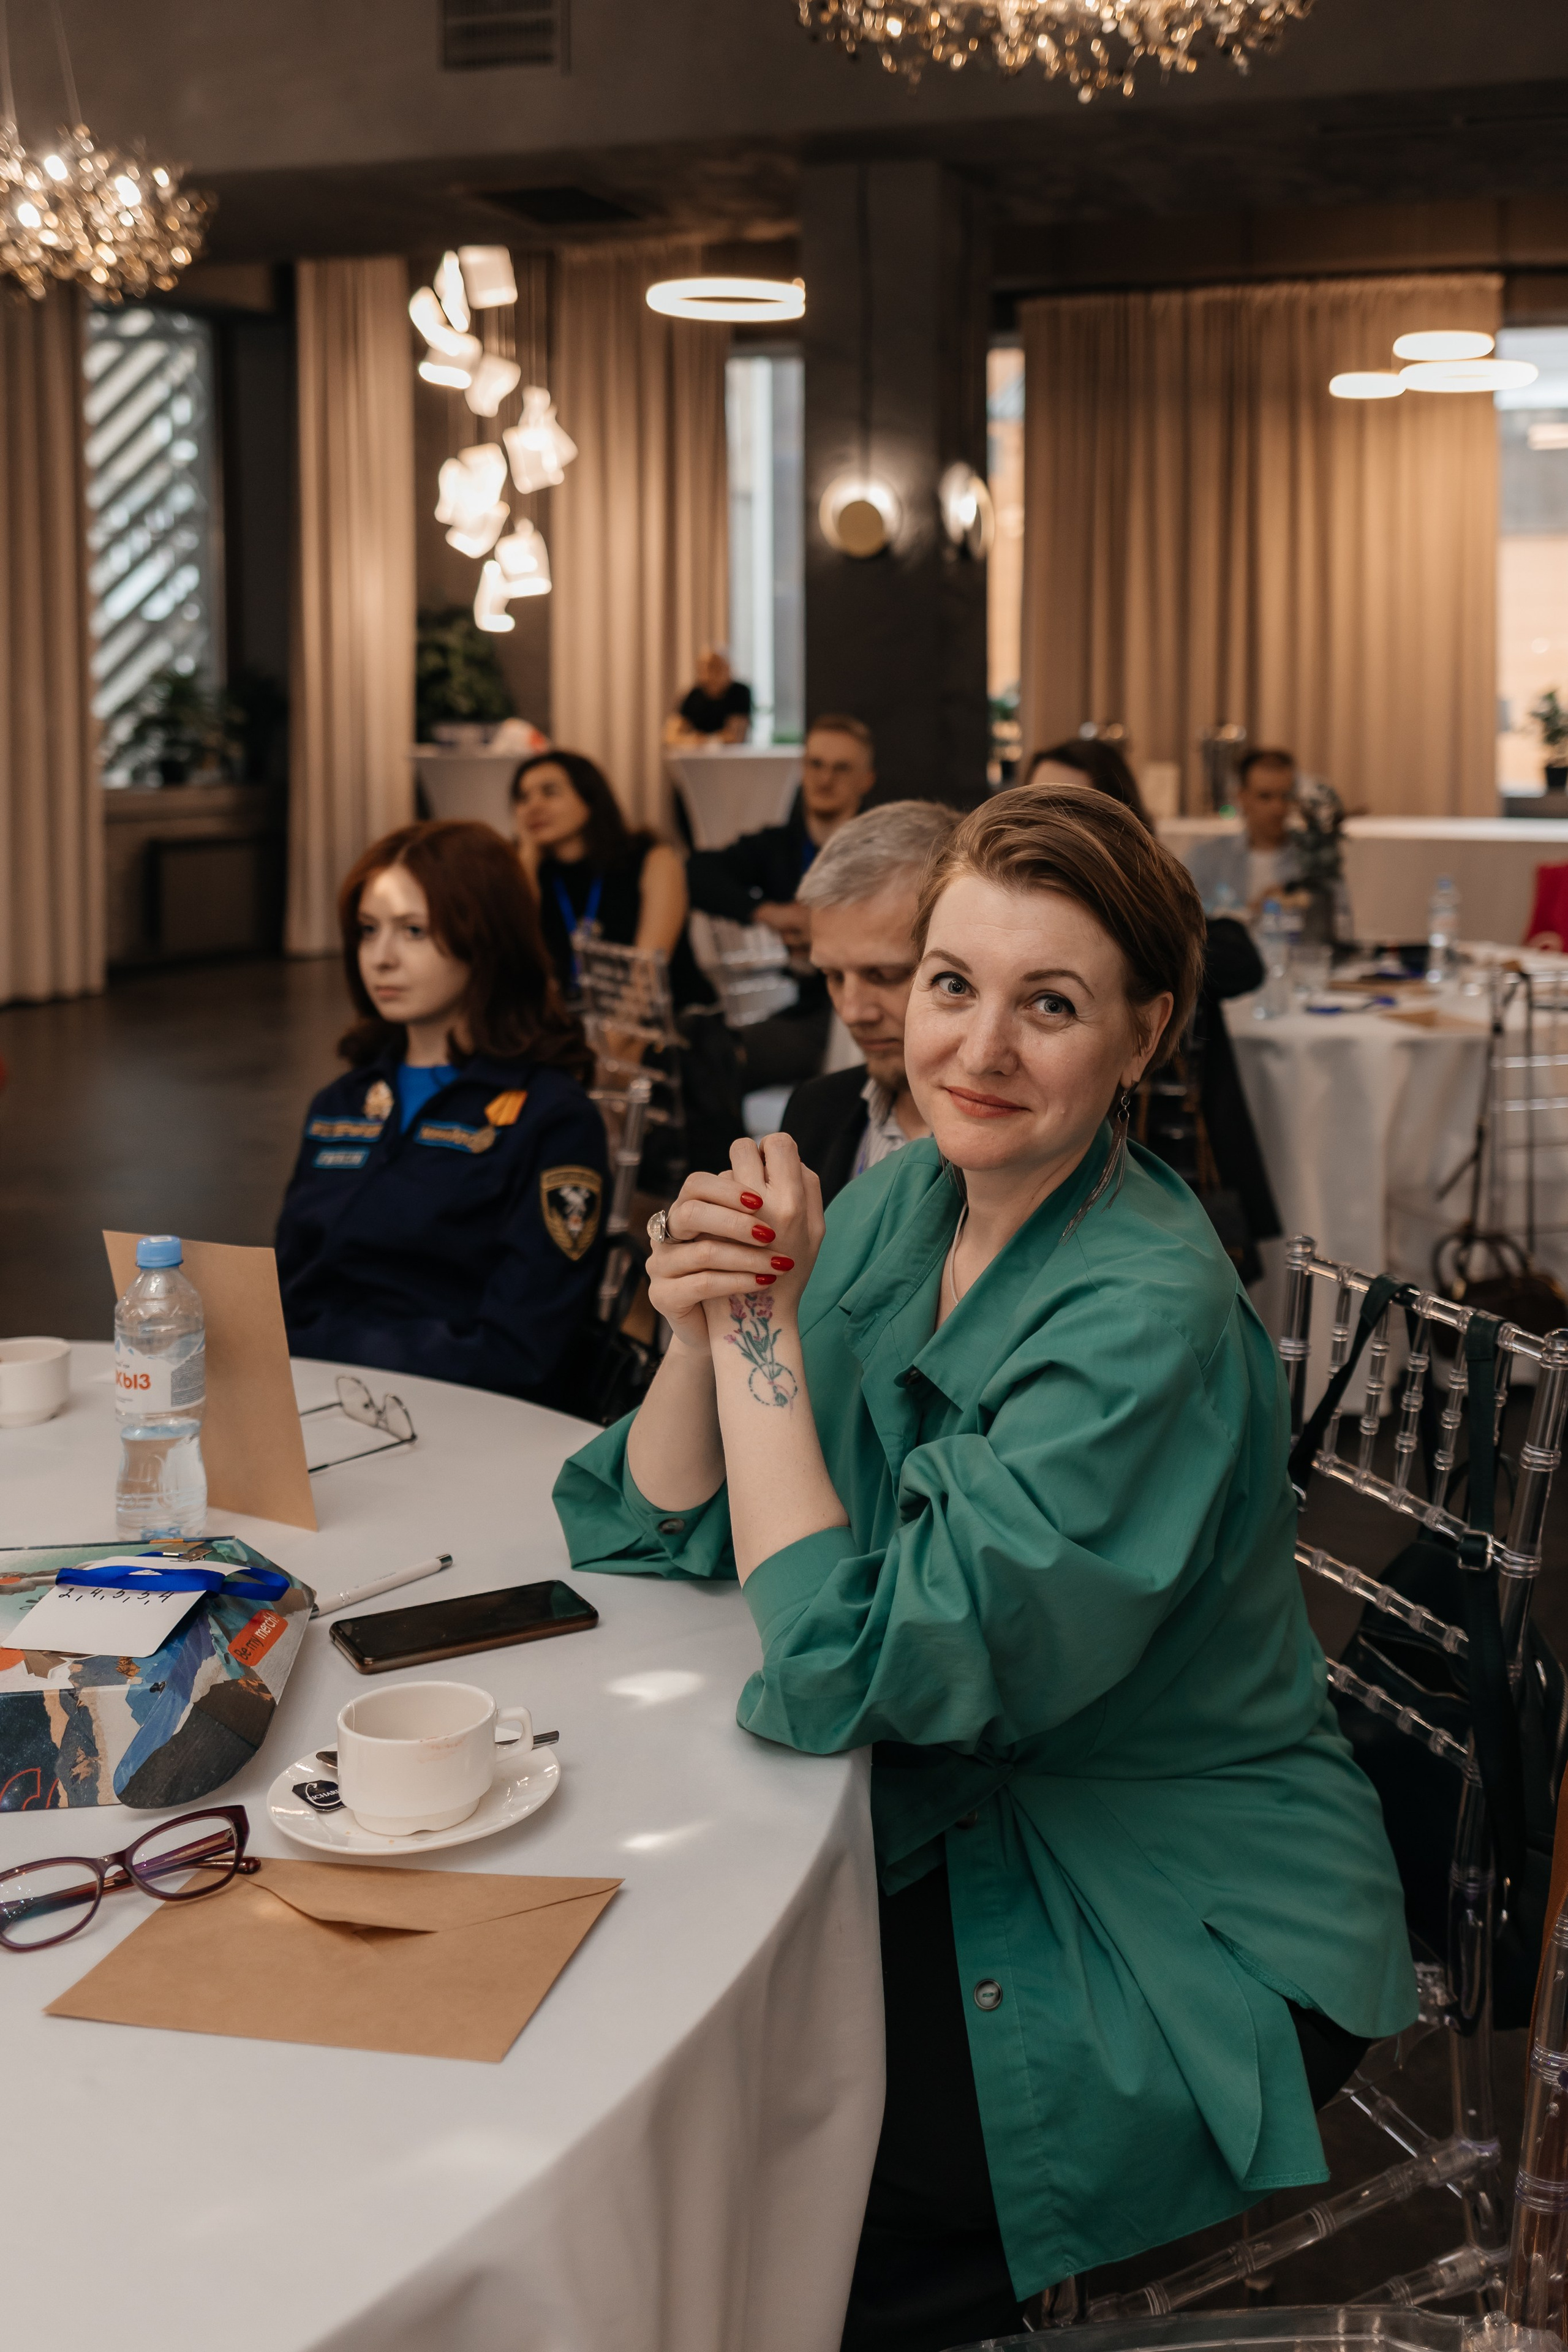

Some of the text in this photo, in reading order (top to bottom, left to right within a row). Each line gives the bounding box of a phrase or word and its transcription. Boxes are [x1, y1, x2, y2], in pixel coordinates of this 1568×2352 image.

[233, 1612, 280, 1660] Be my merch!
